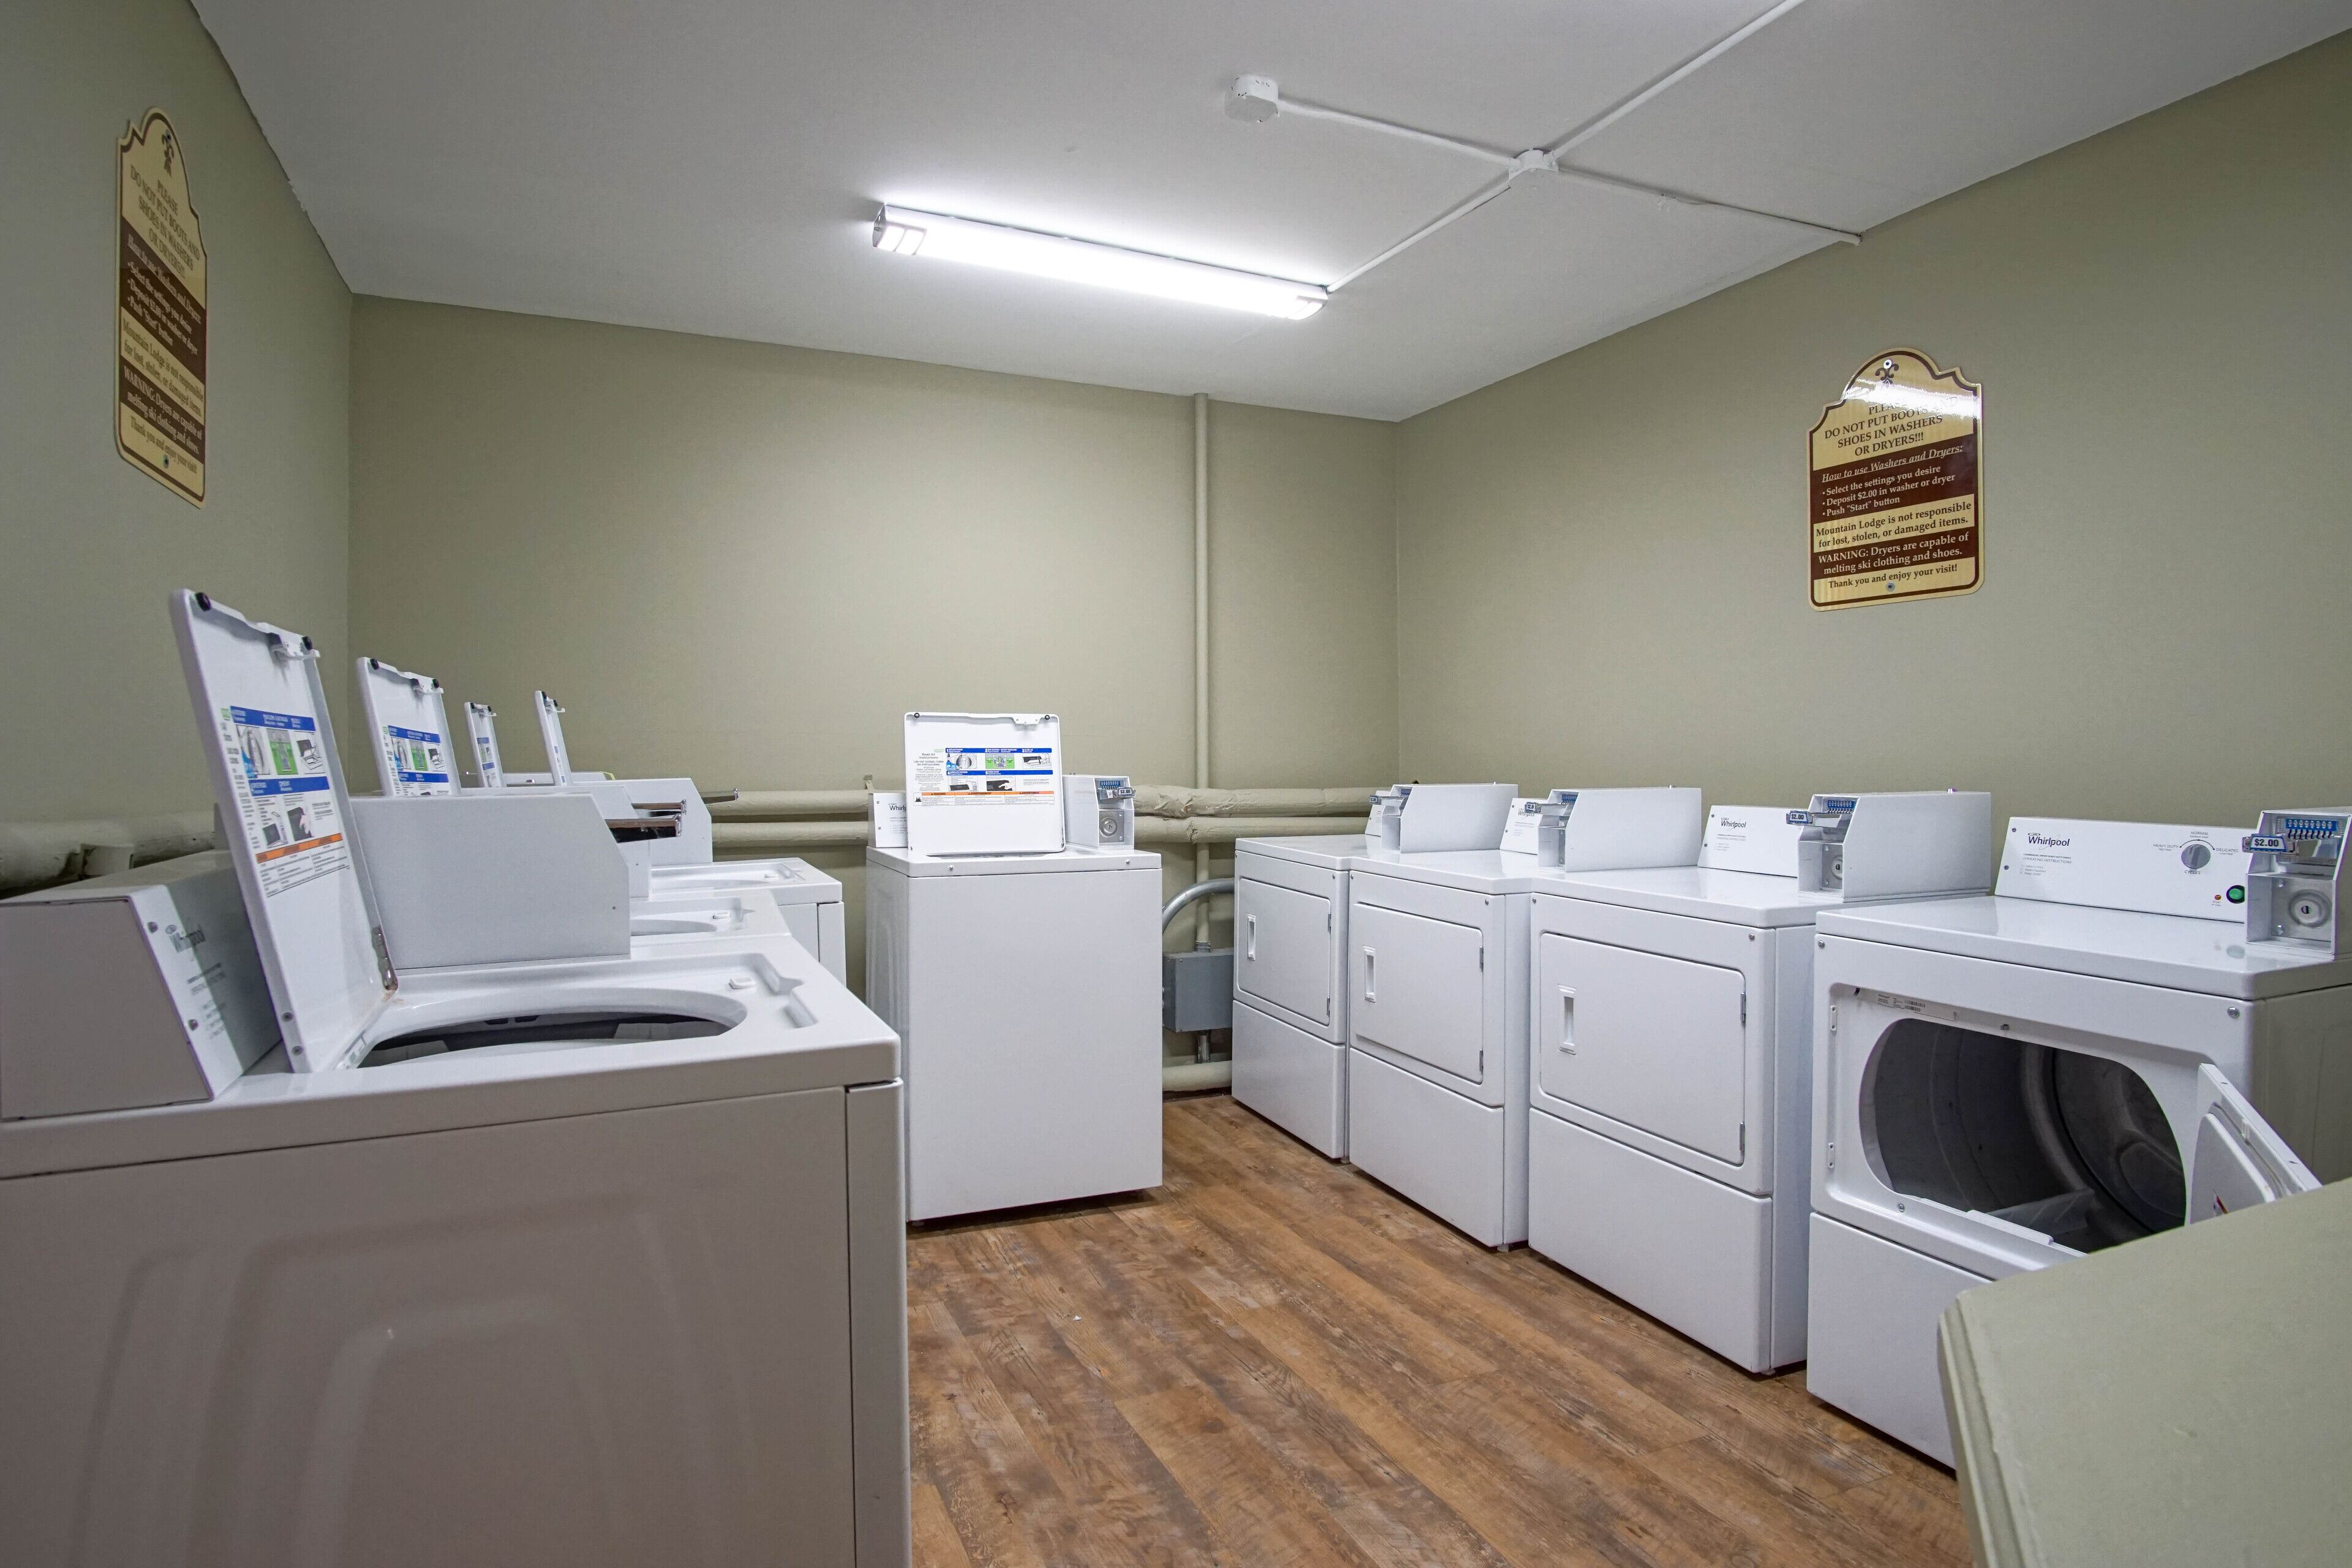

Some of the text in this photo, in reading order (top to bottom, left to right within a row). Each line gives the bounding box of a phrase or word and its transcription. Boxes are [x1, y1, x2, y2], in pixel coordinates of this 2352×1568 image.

[157, 180, 178, 214] PLEASE
[1825, 407, 1928, 439] DO NOT PUT BOOTS
[1838, 415, 1943, 448] SHOES IN WASHERS
[1855, 432, 1924, 456] OR DRYERS!!!
[1822, 445, 1963, 483] How to use Washers and Dryers:
[1826, 485, 1849, 496] Select
[1864, 476, 1895, 488] settings
[1897, 472, 1912, 483] you
[1915, 466, 1940, 477] desire
[1826, 494, 1856, 506] Deposit
[1857, 489, 1877, 500] $2.00
[1889, 482, 1919, 493] washer
[1932, 475, 1955, 485] dryer
[1816, 523, 1856, 537] Mountain
[1859, 518, 1885, 528] Lodge
[1898, 512, 1913, 522] not
[1915, 502, 1971, 519] responsible
[1826, 497, 1900, 516] Push "Start" button
[1819, 539, 1831, 548] for
[1833, 536, 1850, 545] lost,
[1852, 532, 1880, 542] stolen,
[1894, 520, 1936, 535] damaged
[1939, 516, 1968, 527] items.
[1819, 549, 1868, 564] WARNING:
[1871, 545, 1901, 556] Dryers
[1919, 535, 1956, 549] capable
[1958, 532, 1969, 541] of
[1823, 548, 1962, 575] melting ski clothing and shoes.
[1828, 564, 1957, 588] Thank you and enjoy your visit!
[2028, 836, 2070, 847] Whirlpool
[2255, 839, 2278, 847] $2.00
